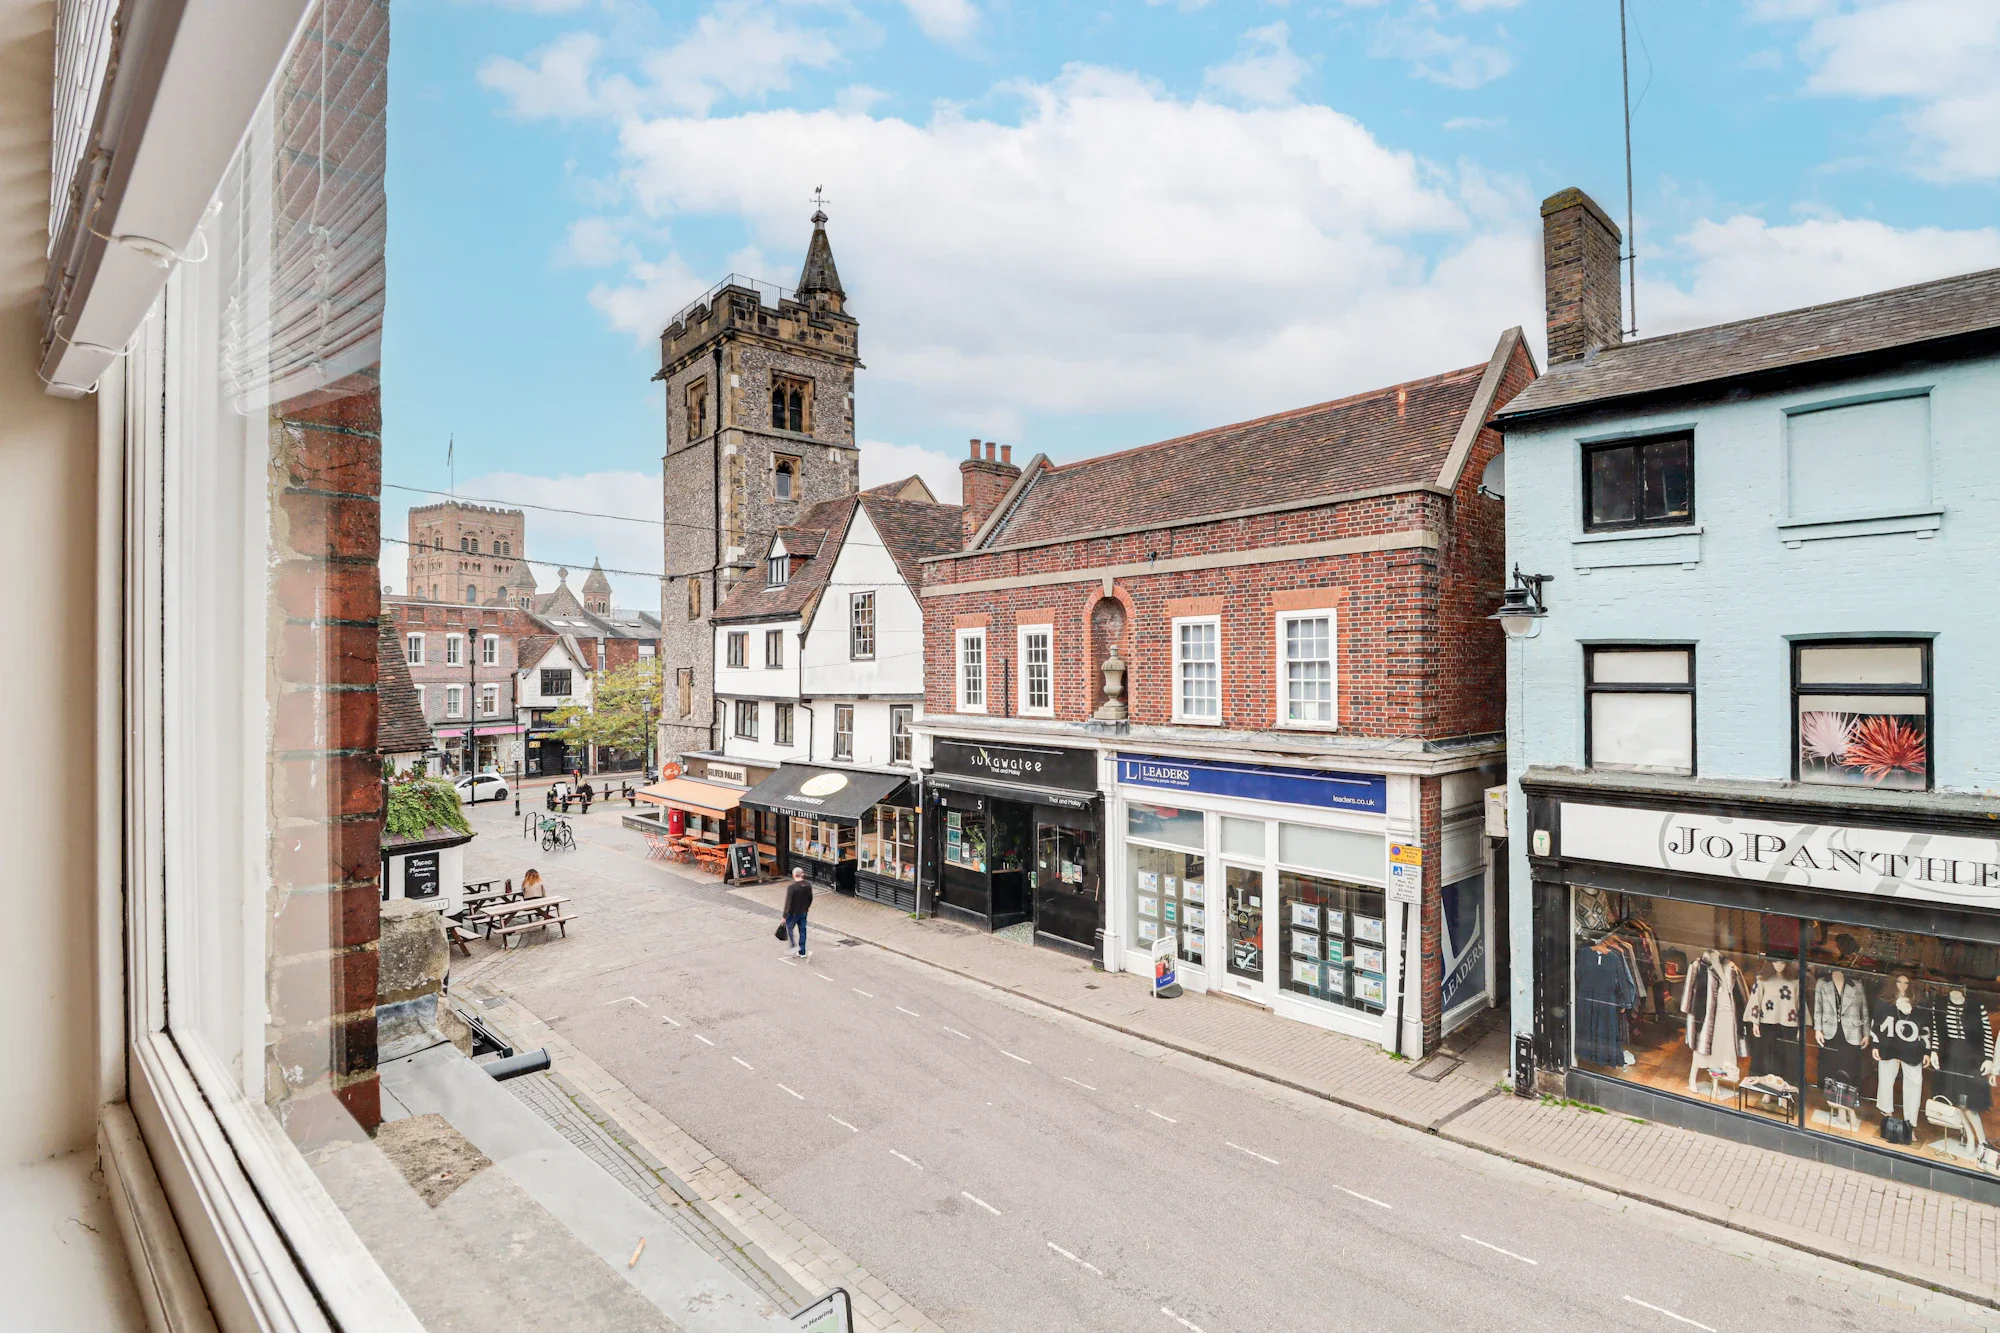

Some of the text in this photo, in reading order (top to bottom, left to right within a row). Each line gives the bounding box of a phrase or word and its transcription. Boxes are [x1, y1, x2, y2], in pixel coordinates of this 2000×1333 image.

[971, 750, 1042, 772] sukawatee
[708, 768, 743, 781] SILVER PALATE
[1125, 762, 1138, 780] L
[1142, 765, 1190, 781] LEADERS
[977, 801, 983, 810] 5
[1048, 796, 1059, 804] Thai
[1068, 799, 1082, 808] Malay
[1332, 794, 1375, 806] leaders.co.uk
[770, 806, 819, 820] THE TRAVEL EXPERTS
[1442, 940, 1484, 1006] LEADERS
[809, 1308, 833, 1325] Hearing
